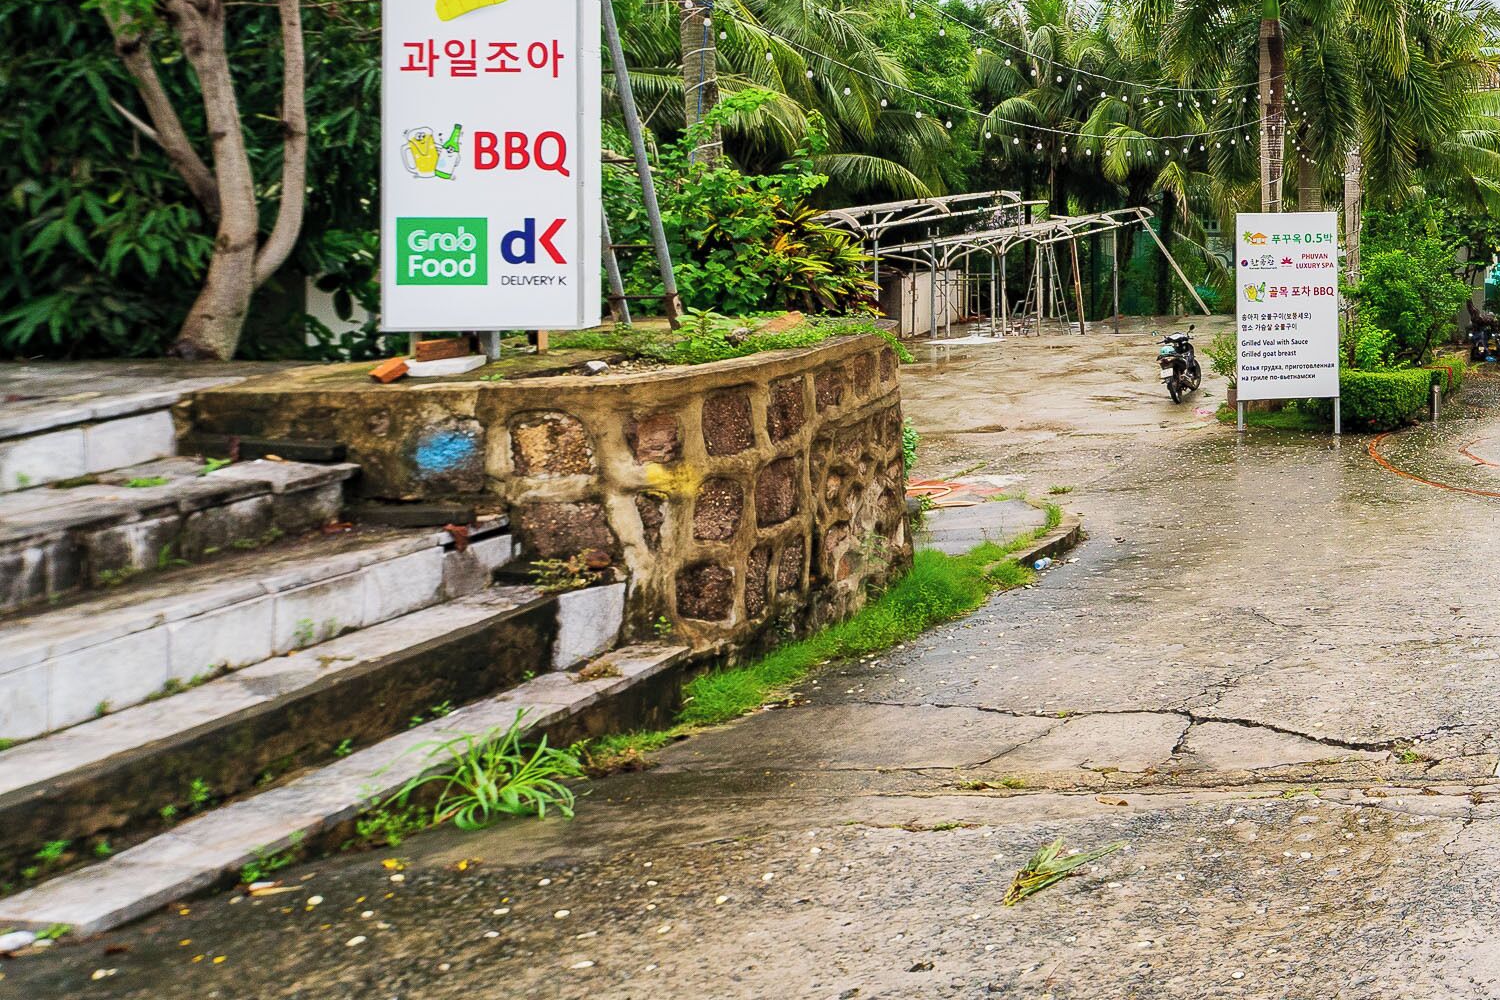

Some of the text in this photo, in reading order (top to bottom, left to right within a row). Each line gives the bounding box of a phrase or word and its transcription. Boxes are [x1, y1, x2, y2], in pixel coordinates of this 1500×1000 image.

[400, 39, 564, 78] 과일조아
[474, 131, 570, 177] BBQ
[407, 226, 477, 252] Grab
[1272, 232, 1333, 244] 푸꾸옥 0.5박
[407, 253, 476, 278] Food
[501, 275, 567, 286] DELIVERY K
[1269, 286, 1334, 298] 골목 포차 BBQ
[1242, 313, 1259, 321] 송아지
